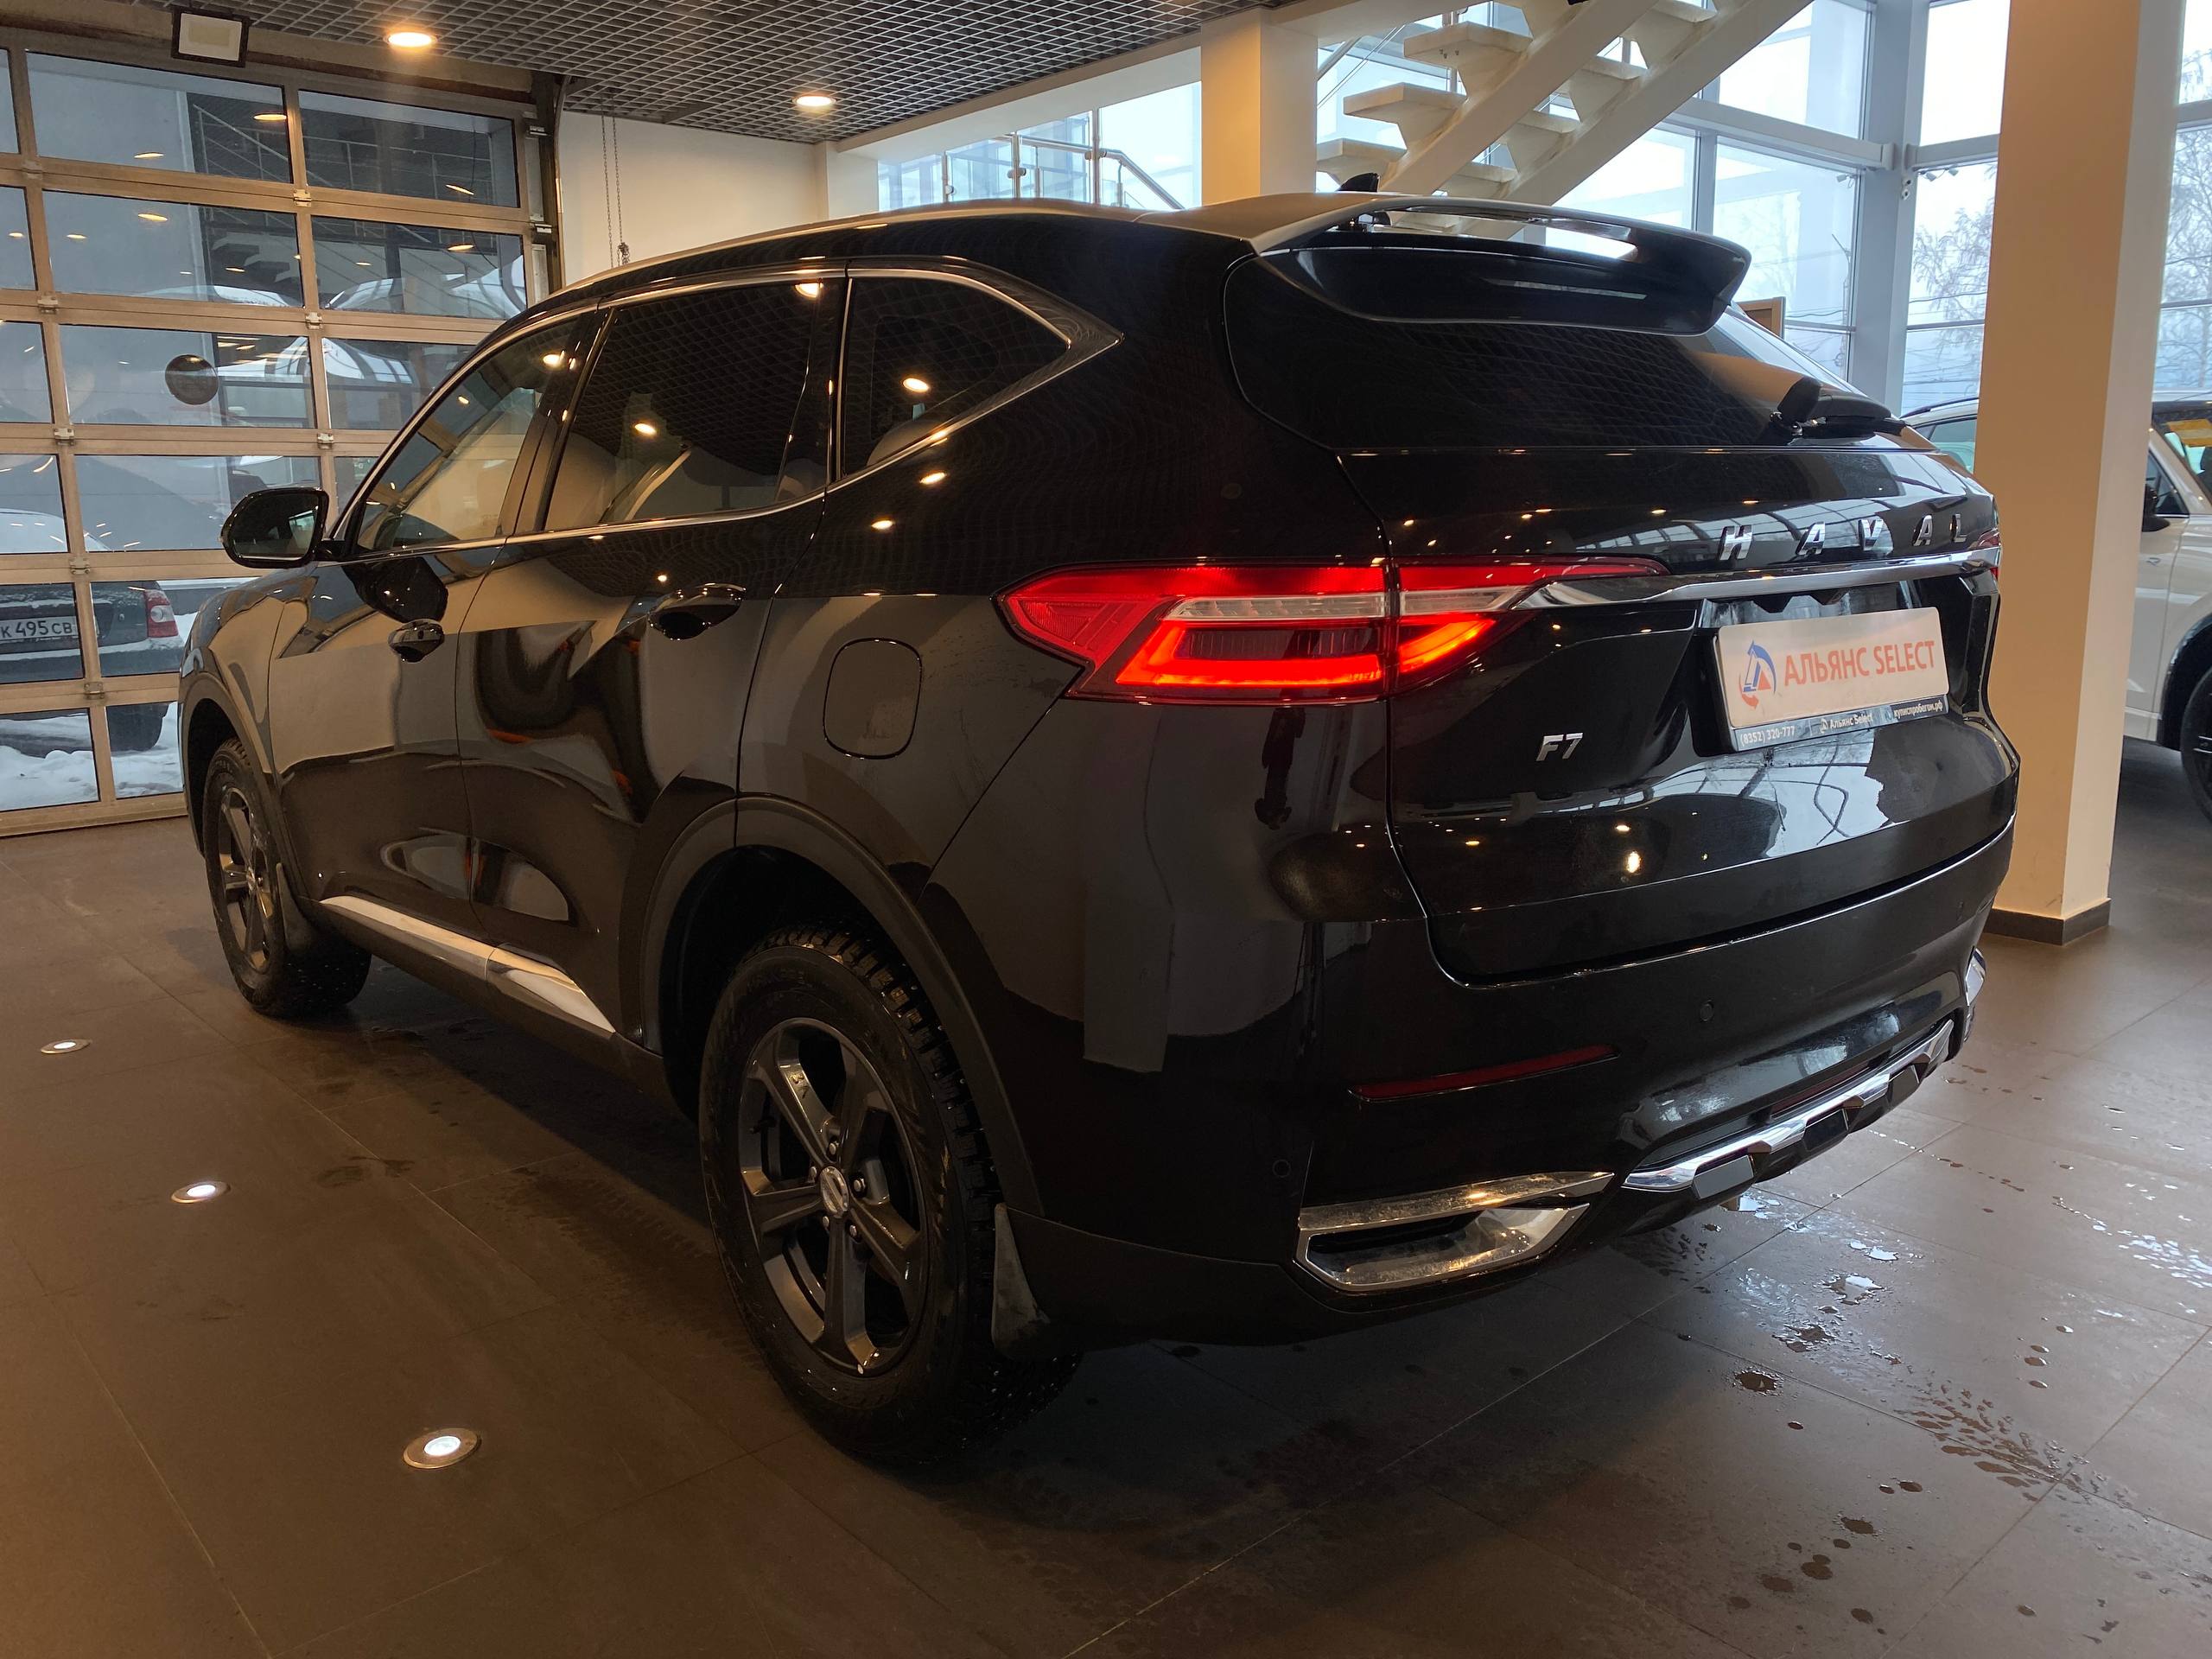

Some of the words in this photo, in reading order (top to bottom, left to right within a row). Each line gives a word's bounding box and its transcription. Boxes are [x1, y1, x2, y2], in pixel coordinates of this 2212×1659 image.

[1719, 513, 1967, 561] HAVAL
[1784, 645, 1870, 686] АЛЬЯНС
[1875, 640, 1936, 675] SELECT
[1829, 717, 1854, 729] Альянс
[1854, 713, 1873, 726] Select
[1535, 732, 1584, 761] F7
[1740, 730, 1766, 747] (8352)
[1766, 726, 1796, 741] 320-777
